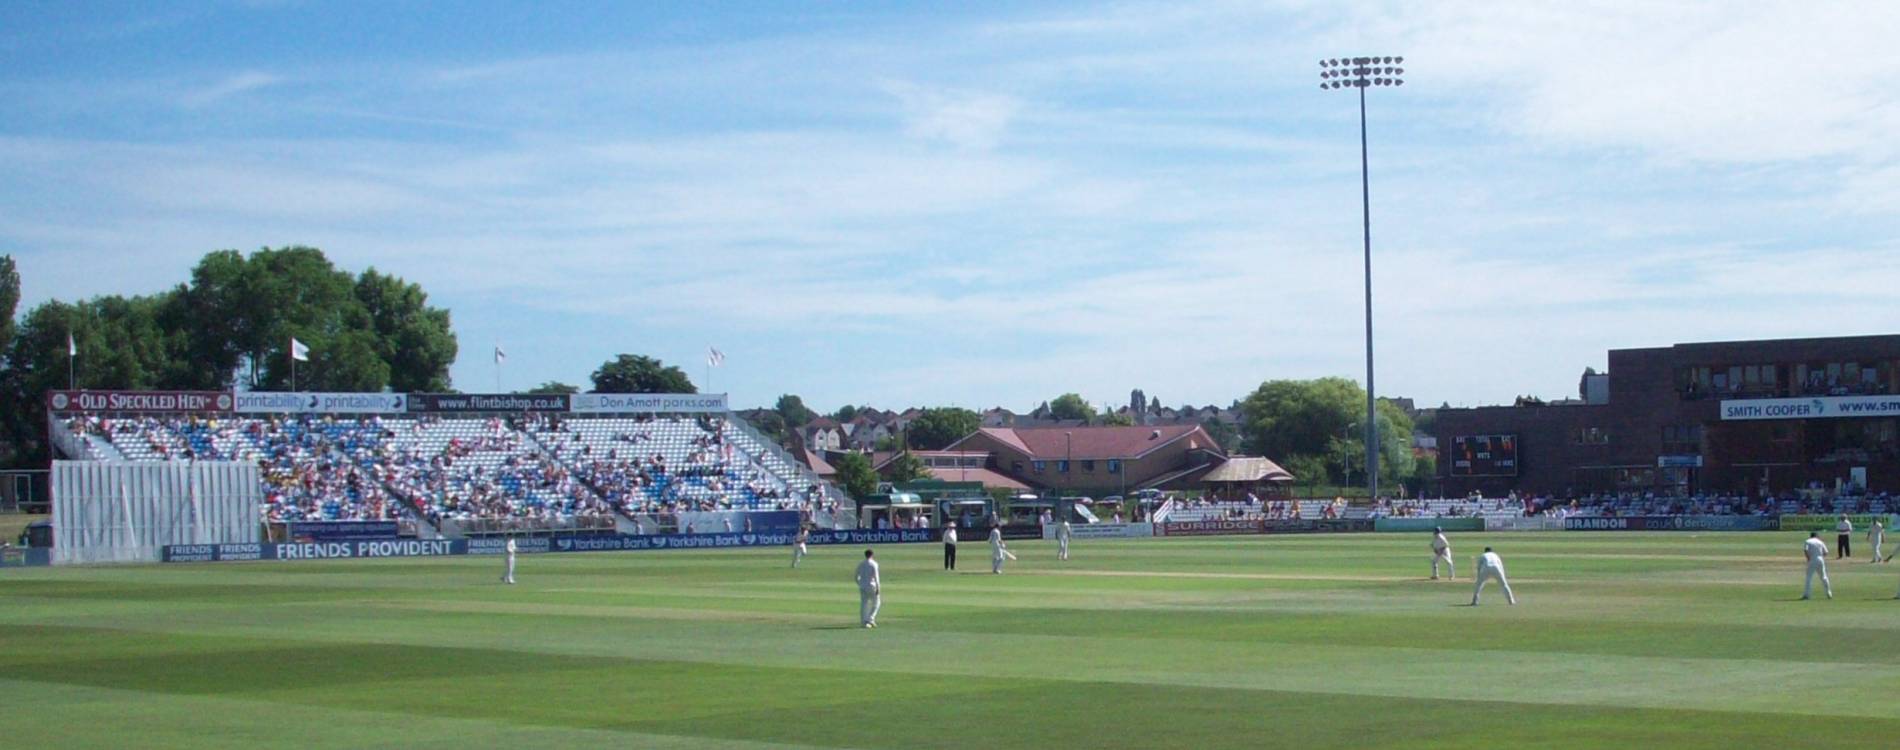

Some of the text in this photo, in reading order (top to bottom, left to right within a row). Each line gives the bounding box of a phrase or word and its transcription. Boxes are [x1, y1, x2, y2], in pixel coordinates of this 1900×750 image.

[109, 393, 175, 409] SPECKLED
[237, 394, 304, 410] printability
[325, 394, 390, 410] printability
[438, 396, 563, 410] www.flintbishop.co.uk
[600, 396, 624, 408] Don
[627, 396, 660, 408] Amott
[663, 397, 722, 410] parks.com
[1727, 404, 1810, 417] SMITH COOPER
[1566, 518, 1627, 529] BRANDON
[574, 537, 649, 549] Yorkshire Bank
[668, 536, 740, 548] Yorkshire Bank
[852, 531, 928, 543] Yorkshire Bank
[170, 544, 212, 554] FRIENDS
[220, 543, 261, 553] FRIENDS
[277, 540, 452, 559] FRIENDS PROVIDENT
